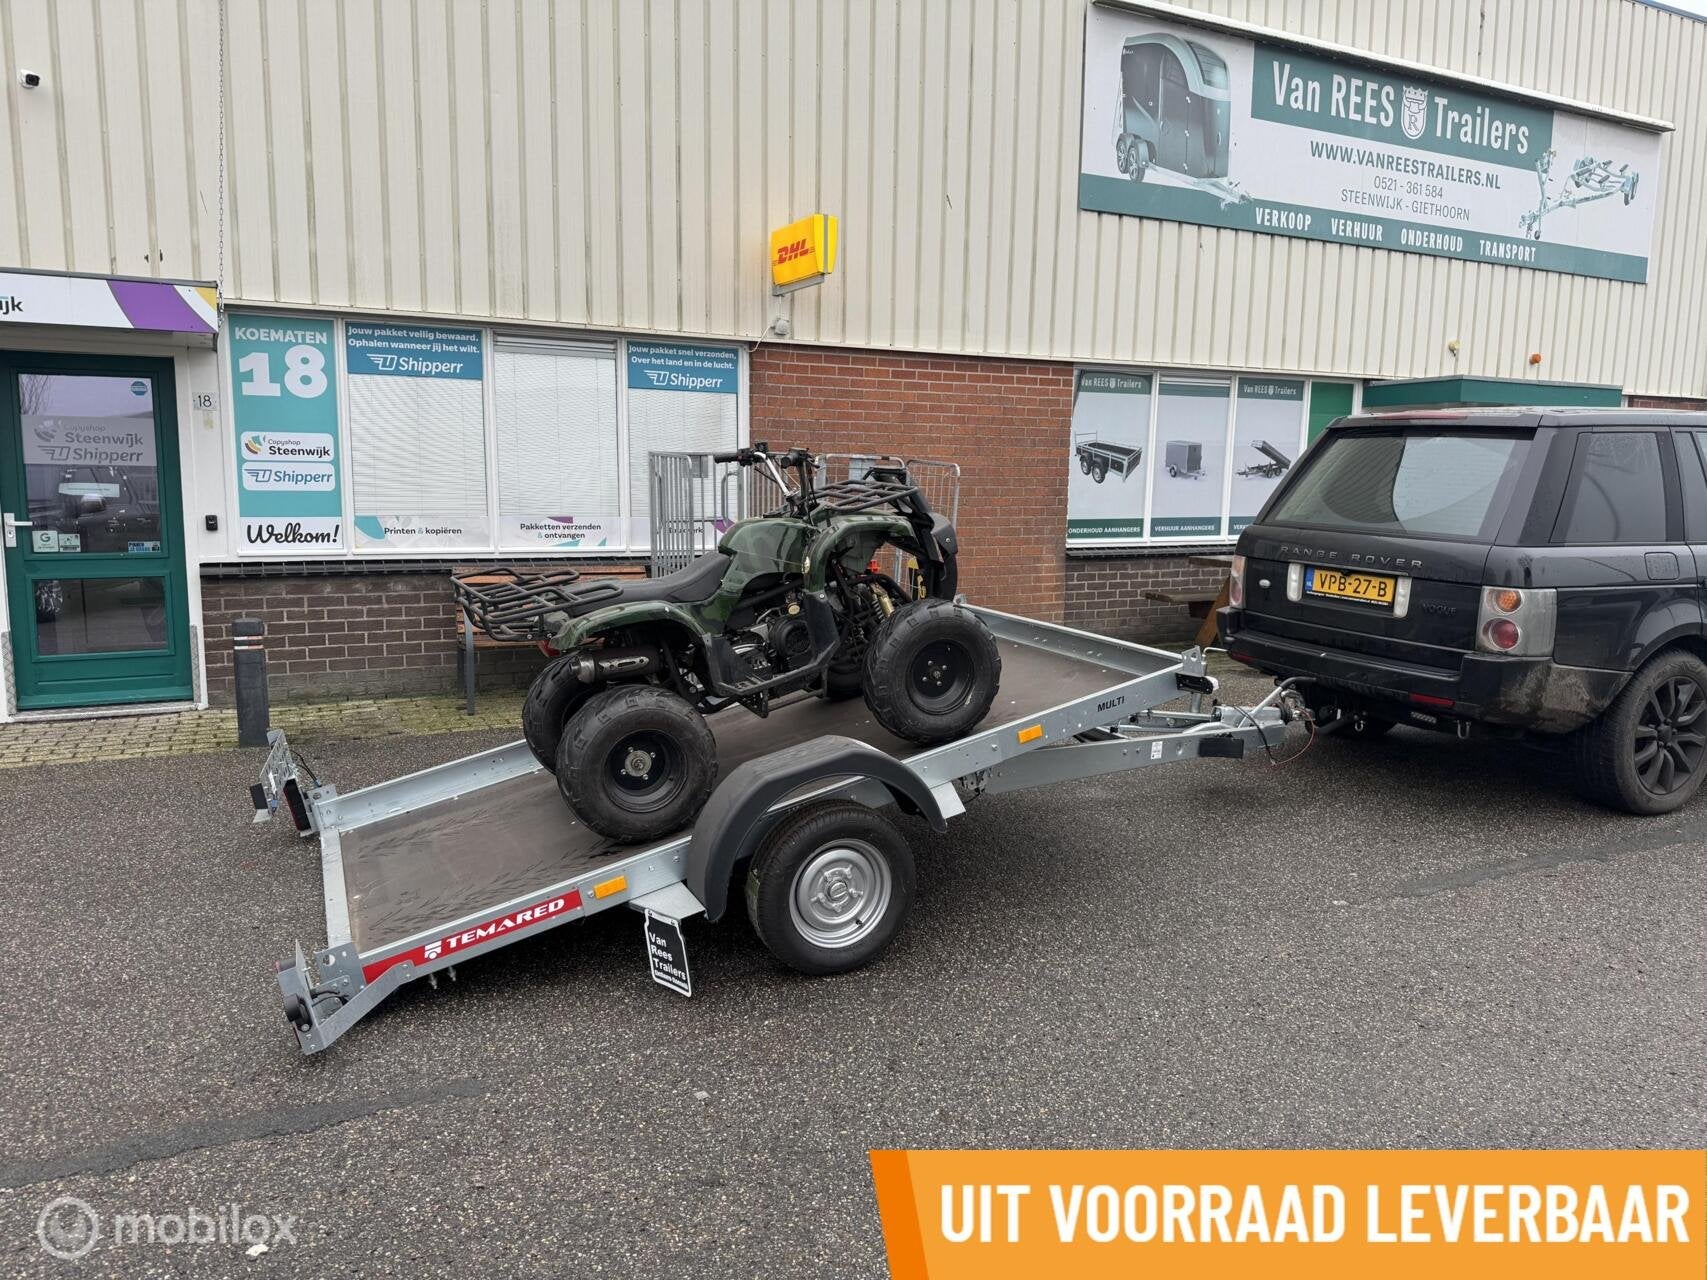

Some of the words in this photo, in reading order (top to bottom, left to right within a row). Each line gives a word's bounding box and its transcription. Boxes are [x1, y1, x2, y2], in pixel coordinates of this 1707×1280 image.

[1272, 60, 1321, 114] Van
[1330, 73, 1394, 128] REES
[1434, 95, 1529, 154] Trailers
[1310, 140, 1501, 189] WWW.VANREESTRAILERS.NL
[1374, 175, 1397, 192] 0521
[1406, 179, 1424, 196] 361
[1425, 182, 1443, 199] 584
[1341, 188, 1402, 210] STEENWIJK
[1412, 200, 1470, 221] GIETHOORN
[1255, 207, 1312, 231] VERKOOP
[1331, 218, 1383, 242] VERHUUR
[1401, 228, 1463, 252] ONDERHOUD
[1480, 239, 1536, 262] TRANSPORT
[777, 238, 809, 264] DHL
[234, 327, 328, 344] KOEMATEN
[348, 326, 372, 336] Jouw
[374, 328, 408, 339] pakket
[409, 330, 434, 341] veilig
[436, 331, 479, 342] bewaard.
[348, 338, 389, 349] Ophalen
[390, 342, 431, 351] wanneer
[431, 342, 441, 353] jij
[443, 343, 458, 352] het
[460, 344, 480, 353] wilt.
[628, 345, 649, 354] Jouw
[650, 347, 677, 356] pakket
[678, 348, 693, 356] snel
[398, 357, 464, 375] Shipperr
[631, 356, 650, 364] Over
[651, 357, 665, 365] het
[665, 358, 683, 366] land
[694, 360, 702, 368] in
[713, 361, 735, 369] lucht.
[238, 345, 328, 399] 18
[670, 373, 723, 389] Shipperr
[1081, 376, 1092, 387] Van
[1093, 377, 1109, 388] REES
[1117, 378, 1142, 389] Trailers
[1244, 384, 1254, 393] Van
[1255, 385, 1268, 394] REES
[1274, 386, 1297, 395] Trailers
[197, 394, 212, 408] 18
[65, 432, 143, 448] Steenwijk
[267, 438, 301, 447] Copyshop
[73, 447, 143, 464] Shipperr
[268, 445, 331, 458] Steenwijk
[273, 470, 333, 485] Shipperr
[246, 523, 340, 544] Welkom!
[384, 526, 416, 535] Printen
[425, 526, 462, 537] kopiëren
[520, 523, 561, 531] Pakketten
[562, 523, 602, 531] verzenden
[1068, 526, 1103, 534] ONDERHOUD
[544, 532, 586, 541] ontvangen
[1280, 545, 1338, 560] RANGE
[1352, 553, 1423, 569] ROVER
[1319, 573, 1388, 598] VPB-27-B
[1097, 695, 1125, 713] MULTI
[446, 898, 565, 949] TEMARED
[649, 932, 667, 948] Van
[651, 945, 673, 962] Rees
[653, 958, 686, 981] Trailers
